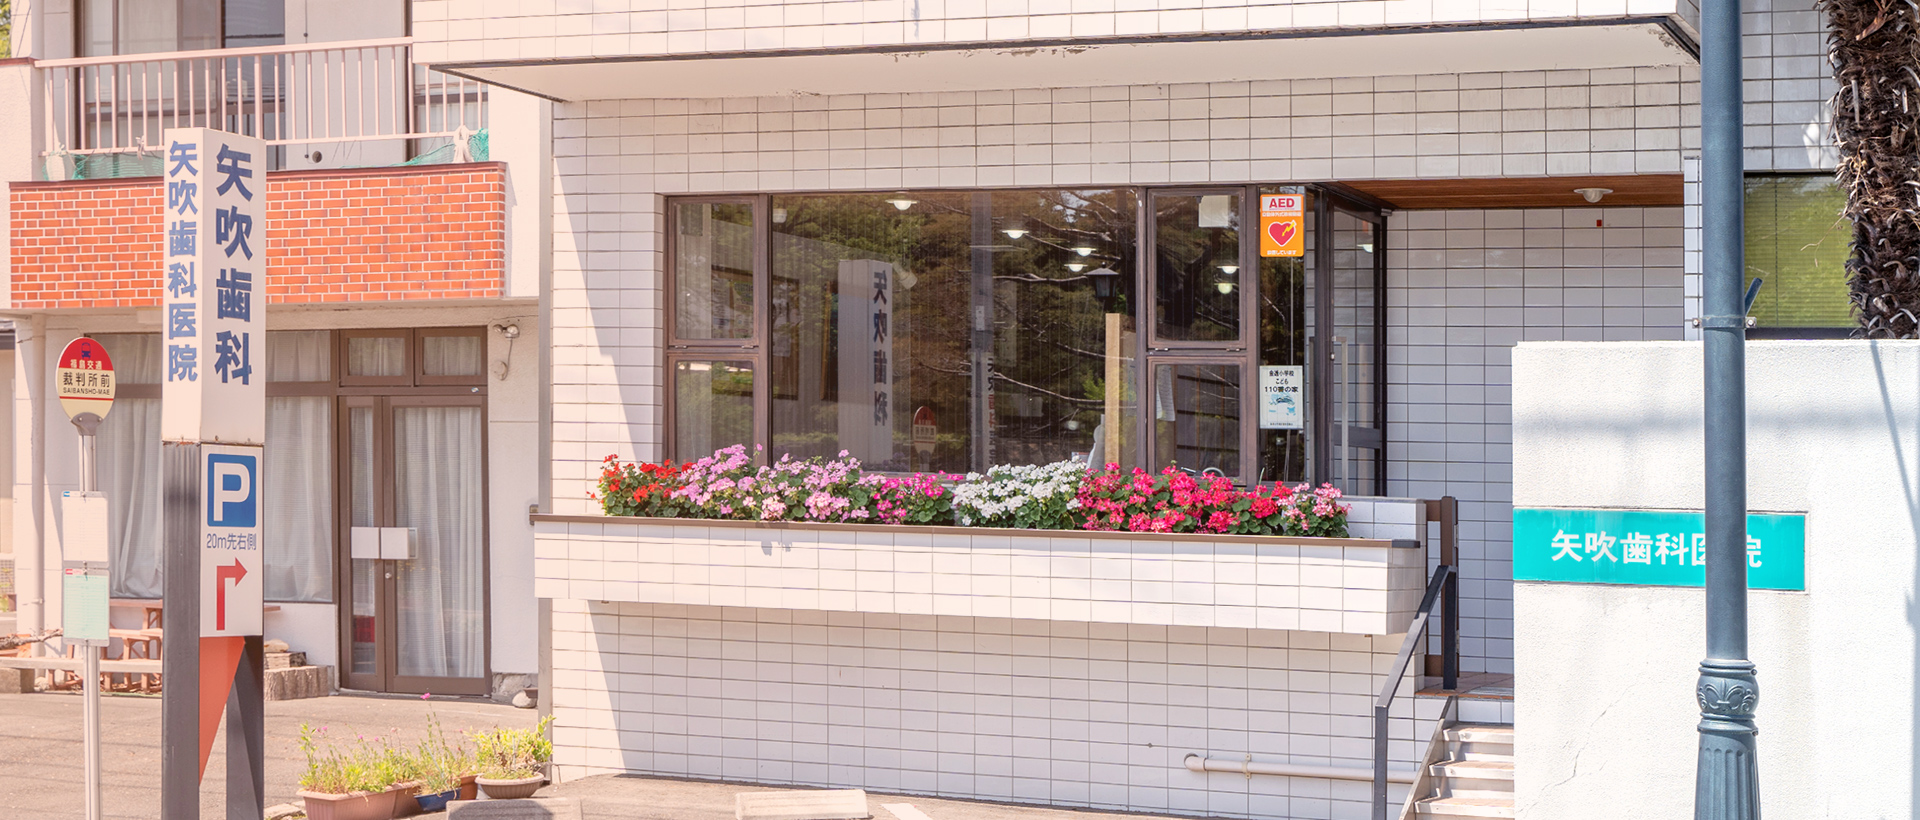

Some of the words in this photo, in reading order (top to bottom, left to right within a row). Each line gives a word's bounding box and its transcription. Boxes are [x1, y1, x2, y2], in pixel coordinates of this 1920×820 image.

[1269, 198, 1295, 208] AED
[168, 140, 198, 382] 矢吹歯科医院
[214, 143, 253, 386] 矢吹歯科
[63, 372, 110, 387] 裁判所前
[63, 387, 110, 395] SAIBANSHO-MAE
[213, 462, 250, 521] P
[206, 533, 257, 550] 20m先右側
